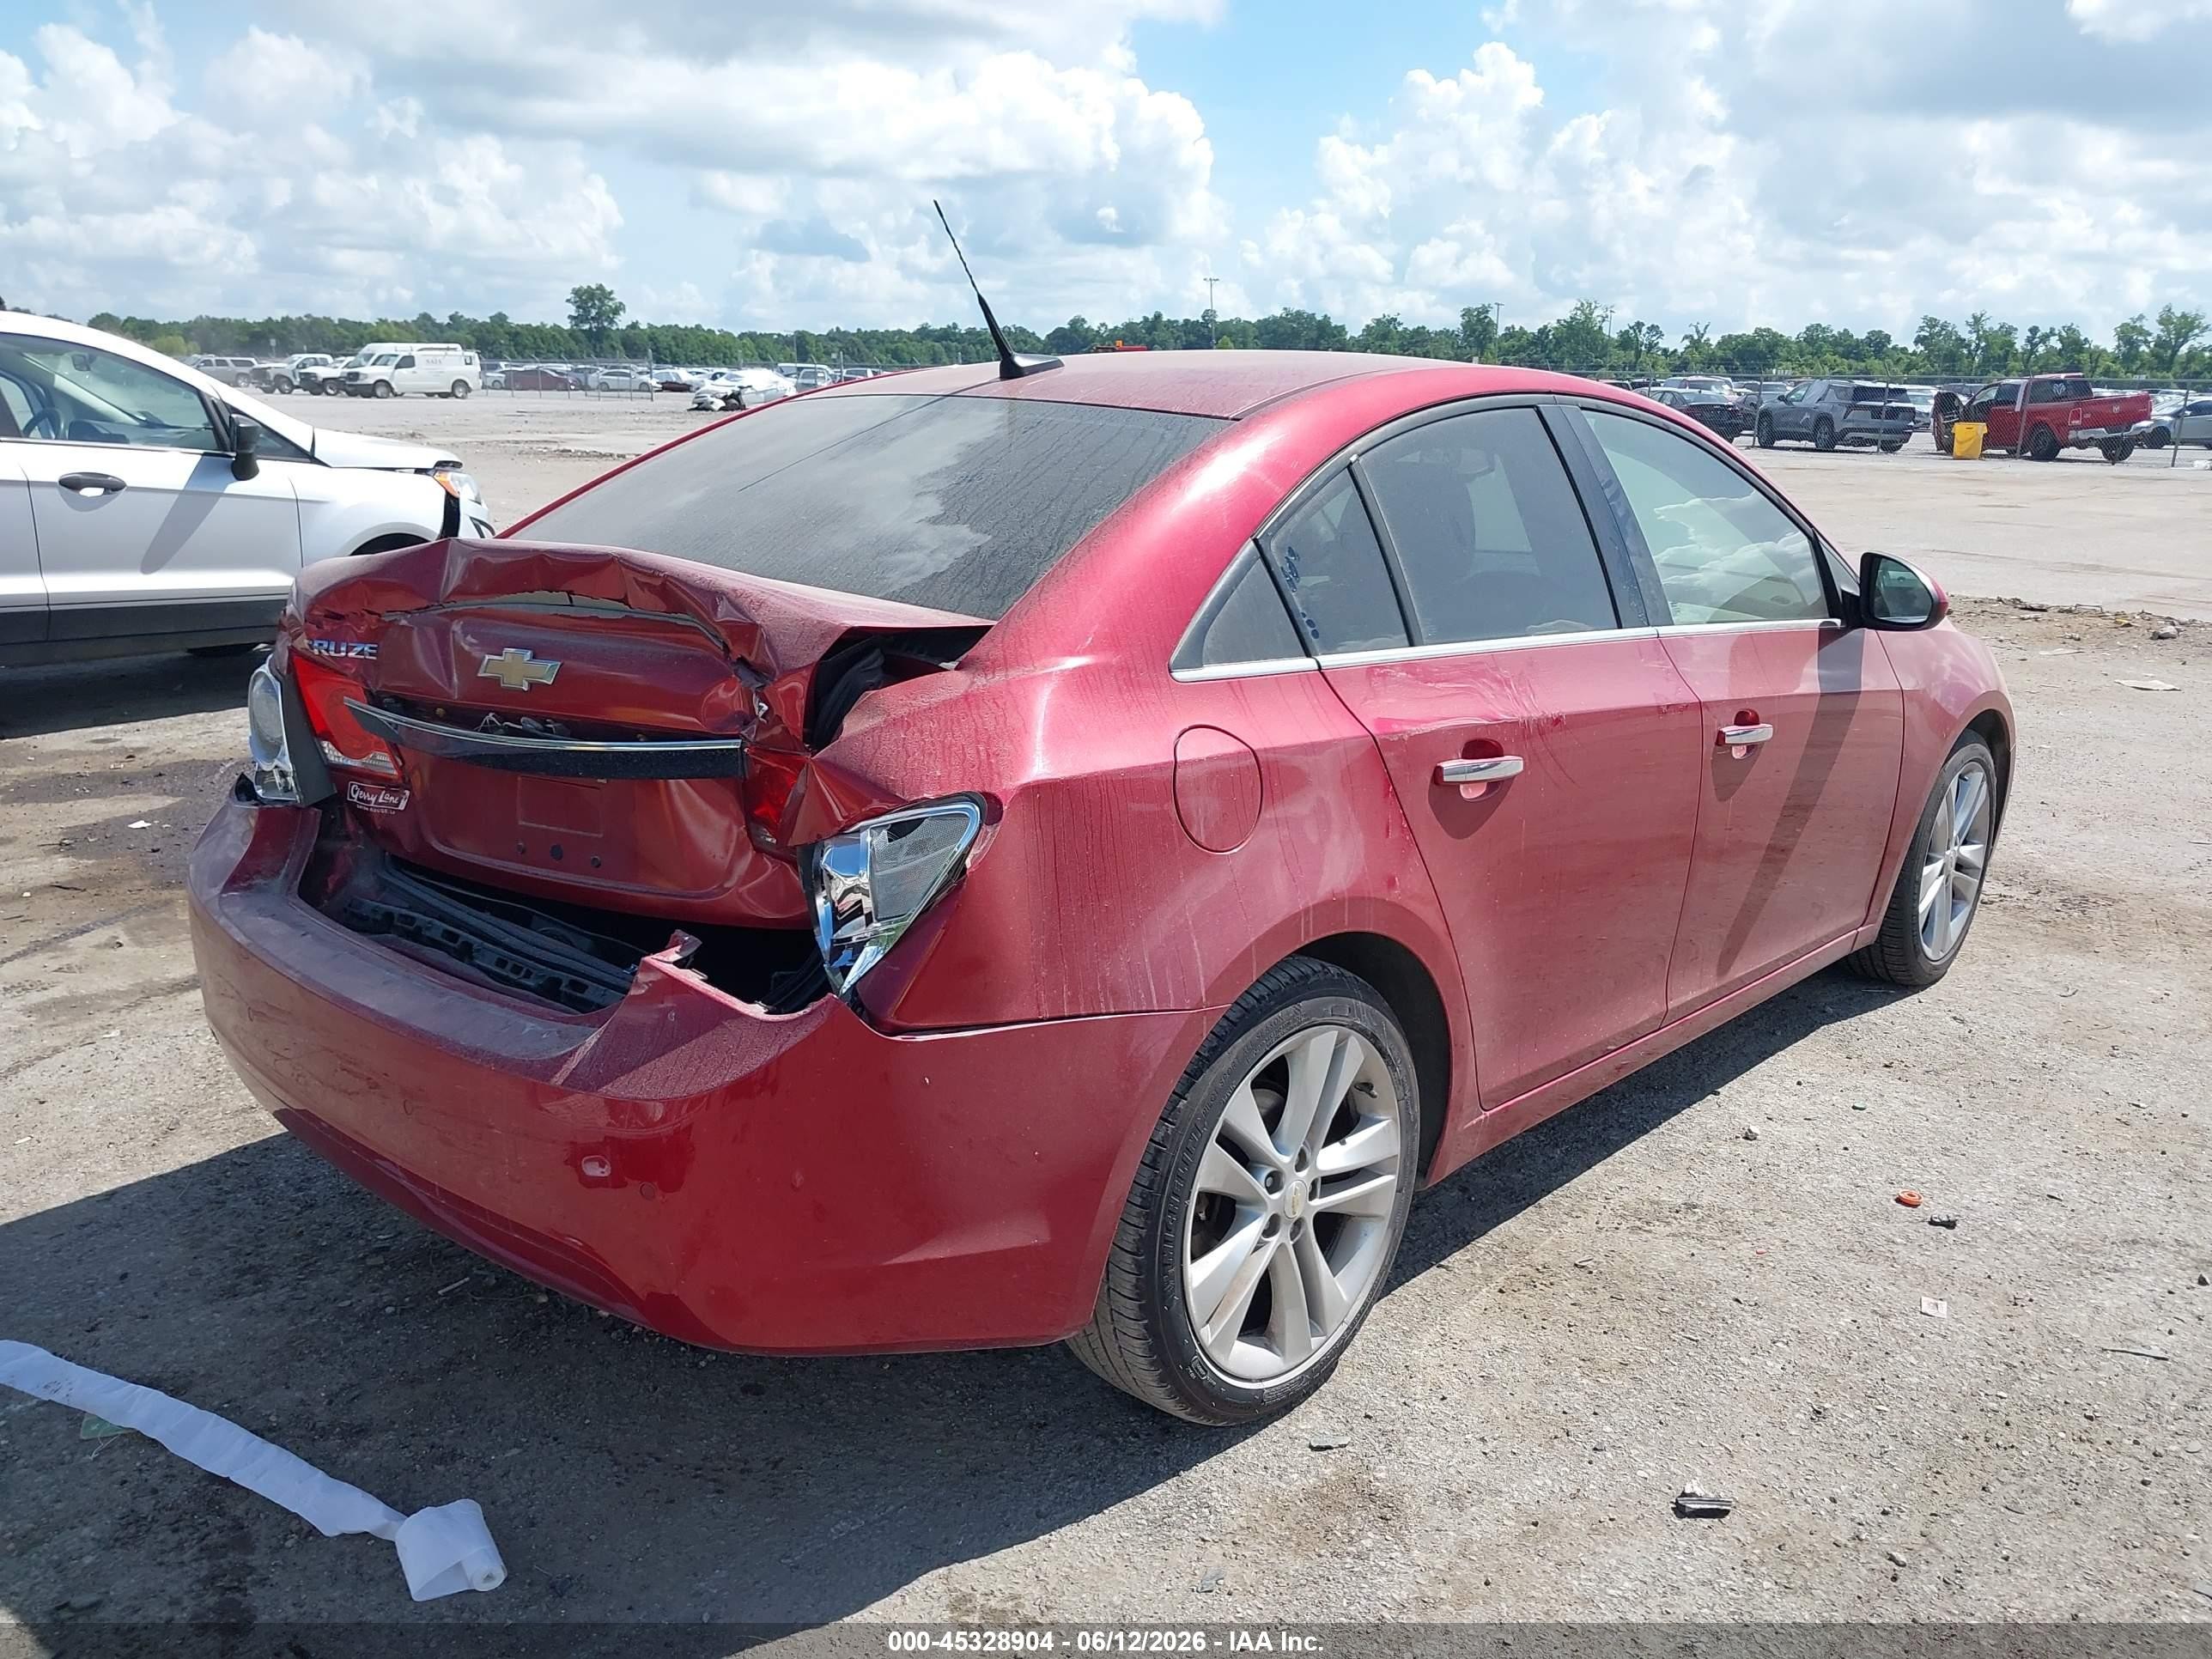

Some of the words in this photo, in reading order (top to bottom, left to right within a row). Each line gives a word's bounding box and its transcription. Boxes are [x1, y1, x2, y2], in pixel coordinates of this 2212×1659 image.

[308, 640, 379, 660] RUZE
[350, 784, 378, 805] Gerry
[378, 790, 399, 804] Lane
